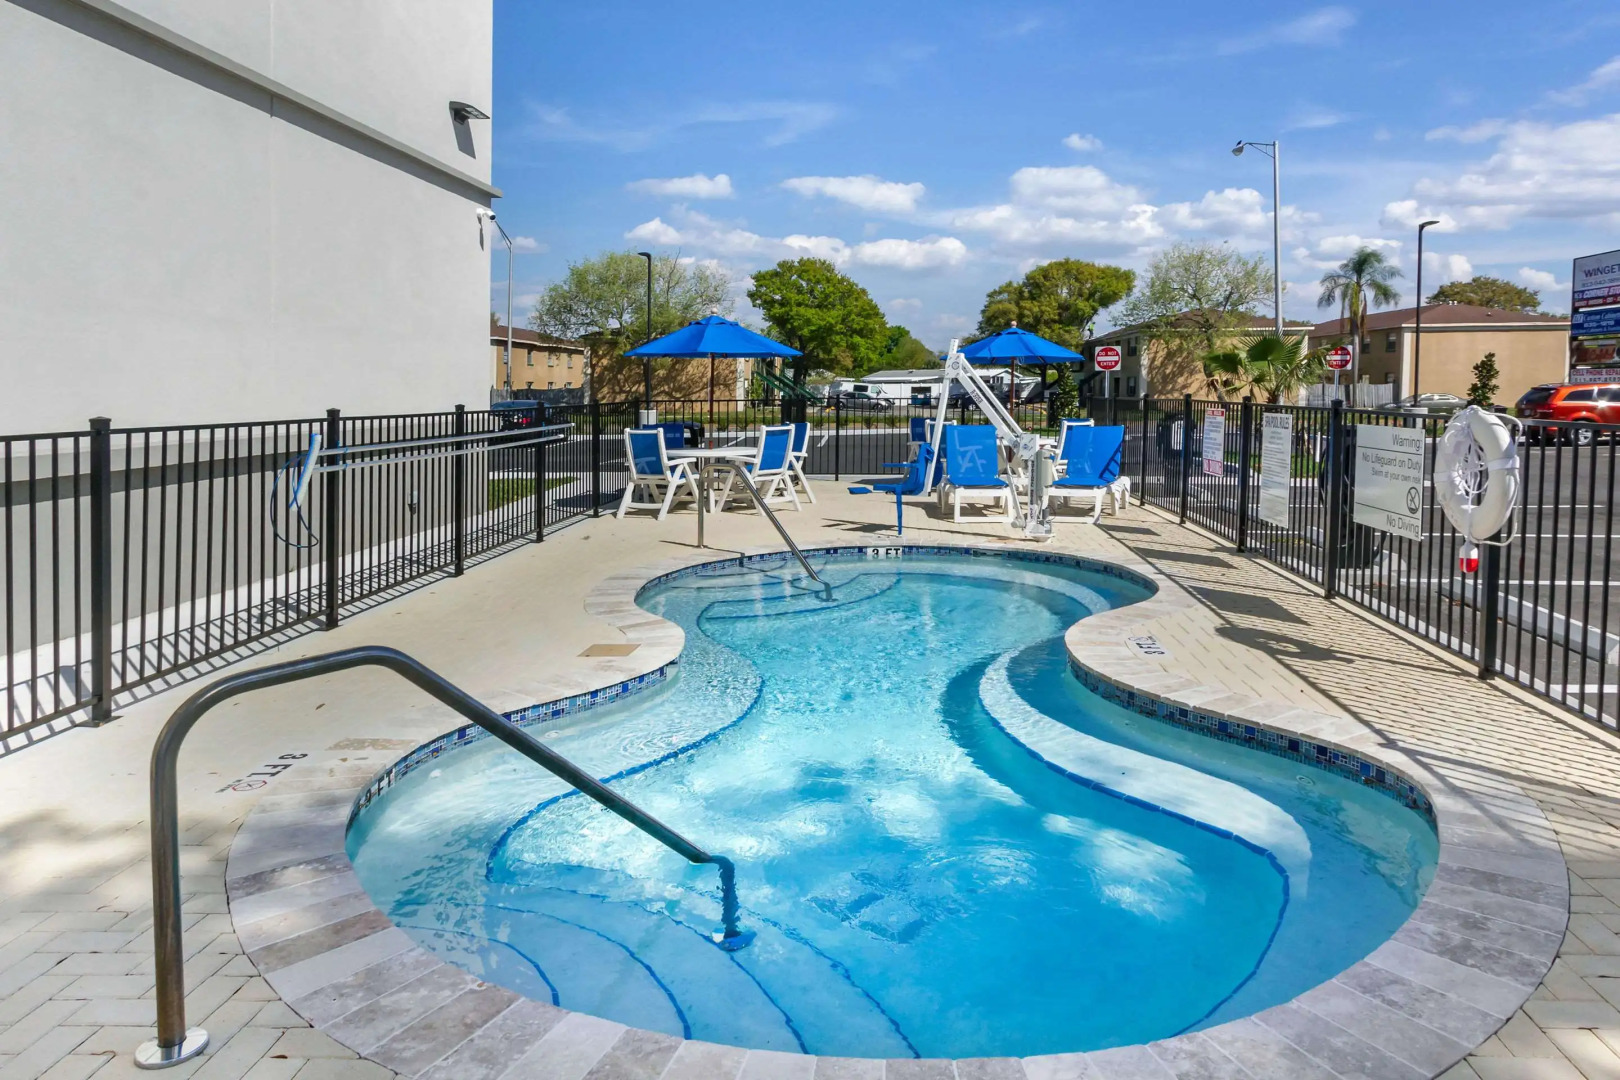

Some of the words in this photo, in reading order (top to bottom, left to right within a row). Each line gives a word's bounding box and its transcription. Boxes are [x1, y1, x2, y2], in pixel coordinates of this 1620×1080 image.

[1362, 452, 1370, 463] No
[1371, 453, 1397, 468] Lifeguard
[1398, 459, 1405, 468] on
[1407, 458, 1421, 474] Duty
[1371, 467, 1383, 478] Swim
[1384, 470, 1389, 478] at
[1389, 472, 1400, 481] your
[1401, 474, 1411, 482] own
[1412, 475, 1421, 484] risk
[1386, 513, 1396, 528] No
[1397, 515, 1419, 538] Diving
[885, 548, 901, 556] FT
[246, 764, 293, 778] FT
